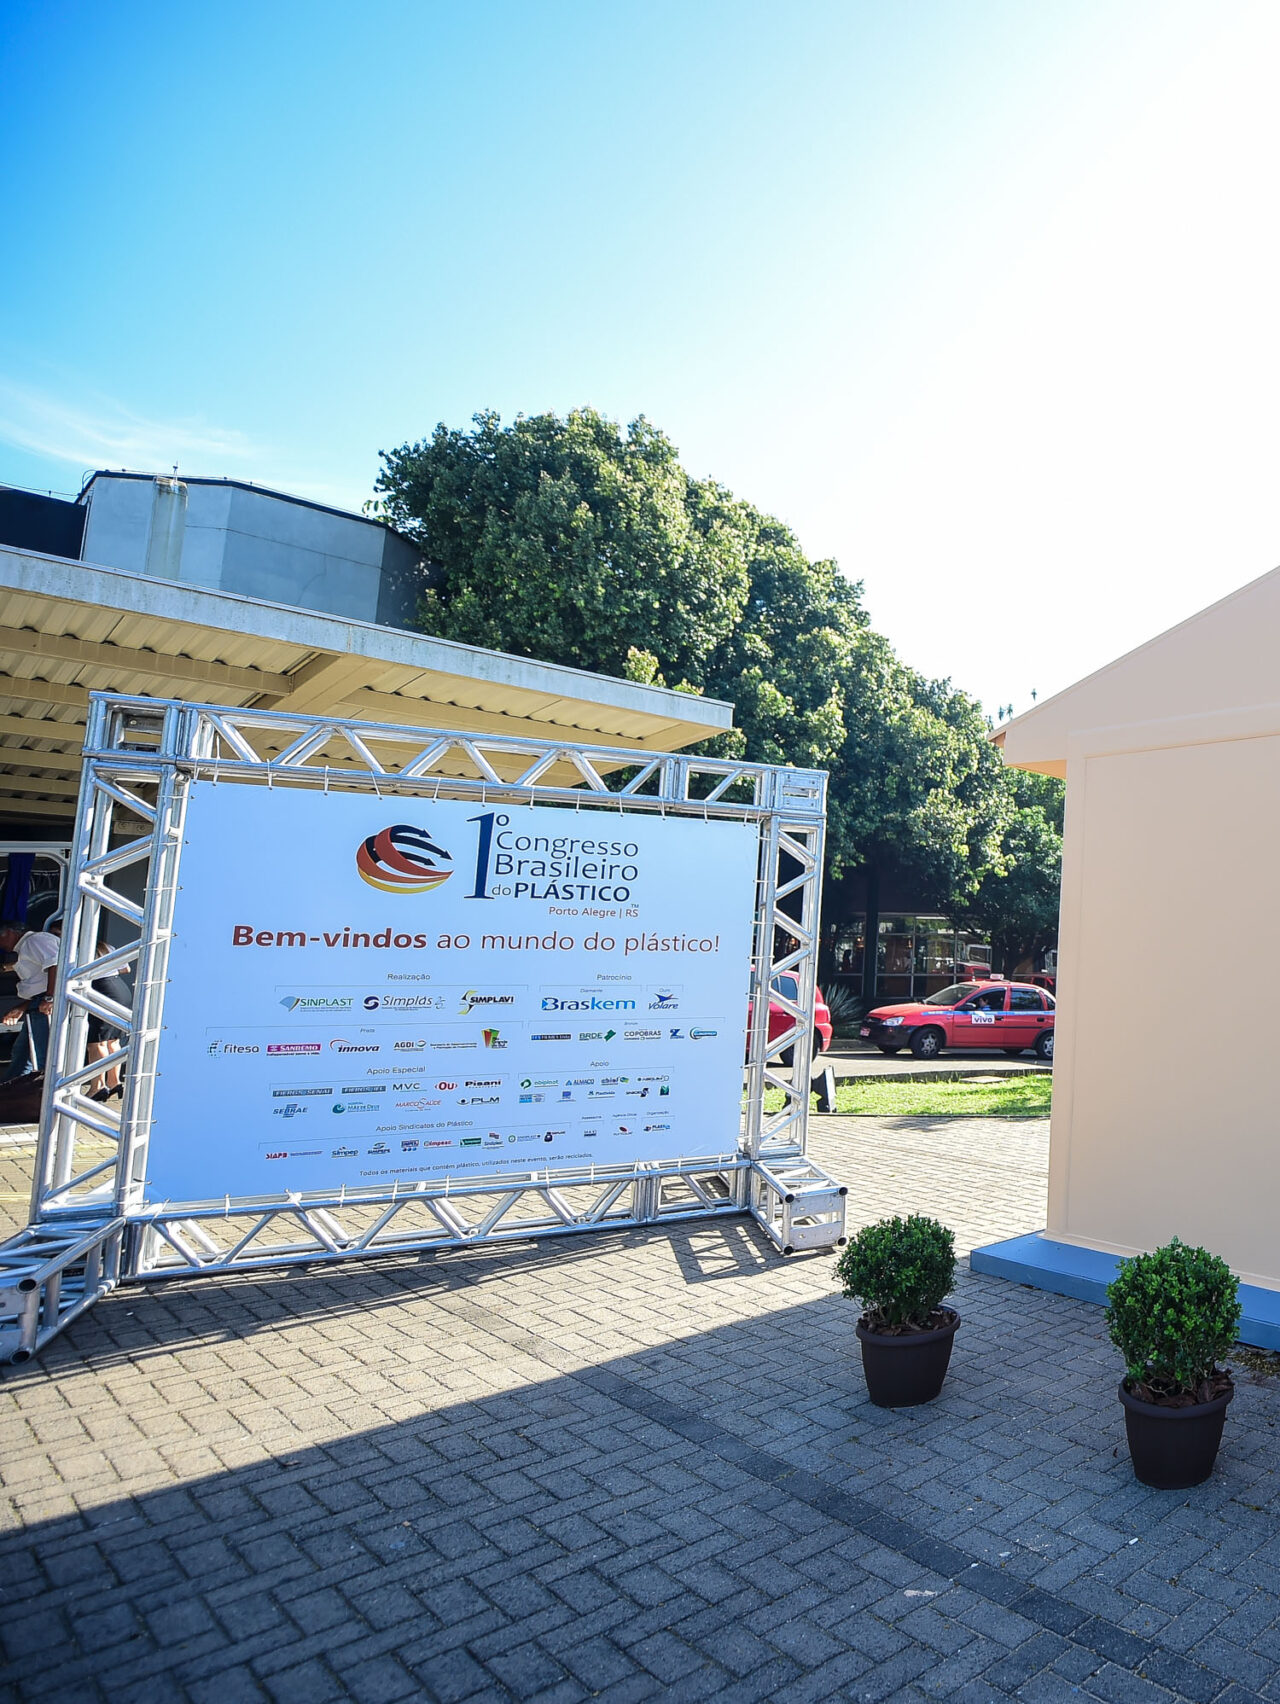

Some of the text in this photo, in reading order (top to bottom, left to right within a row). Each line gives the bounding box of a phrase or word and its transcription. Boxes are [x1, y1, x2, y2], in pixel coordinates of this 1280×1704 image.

[496, 831, 639, 858] Congresso
[495, 855, 639, 882] Brasileiro
[491, 879, 630, 902] do PLÁSTICO
[549, 906, 579, 917] Porto
[581, 907, 617, 918] Alegre
[625, 908, 639, 918] RS
[232, 925, 720, 957] Bem-vindos ao mundo do plástico!
[387, 973, 431, 982] Realização
[596, 973, 632, 982] Patrocínio
[300, 998, 354, 1007] SINPLAST
[382, 995, 433, 1008] Simplás
[468, 995, 514, 1004] SIMPLAVI
[541, 997, 636, 1011] Braskem
[648, 1001, 680, 1010] Volare
[973, 1016, 993, 1024] vivo
[223, 1043, 260, 1054] fitesa
[338, 1045, 380, 1053] innova
[366, 1066, 426, 1075] Apoio Especial
[393, 1083, 420, 1091] MVC
[464, 1079, 502, 1087] Pisani
[471, 1096, 500, 1104] PLM
[272, 1107, 308, 1115] SEBRAE
[399, 1122, 435, 1131] Sindicatos
[432, 1163, 455, 1171] contém
[481, 1159, 509, 1167] utilizados
[527, 1155, 547, 1163] evento,
[548, 1153, 564, 1161] serão
[565, 1152, 593, 1160] reciclados.
